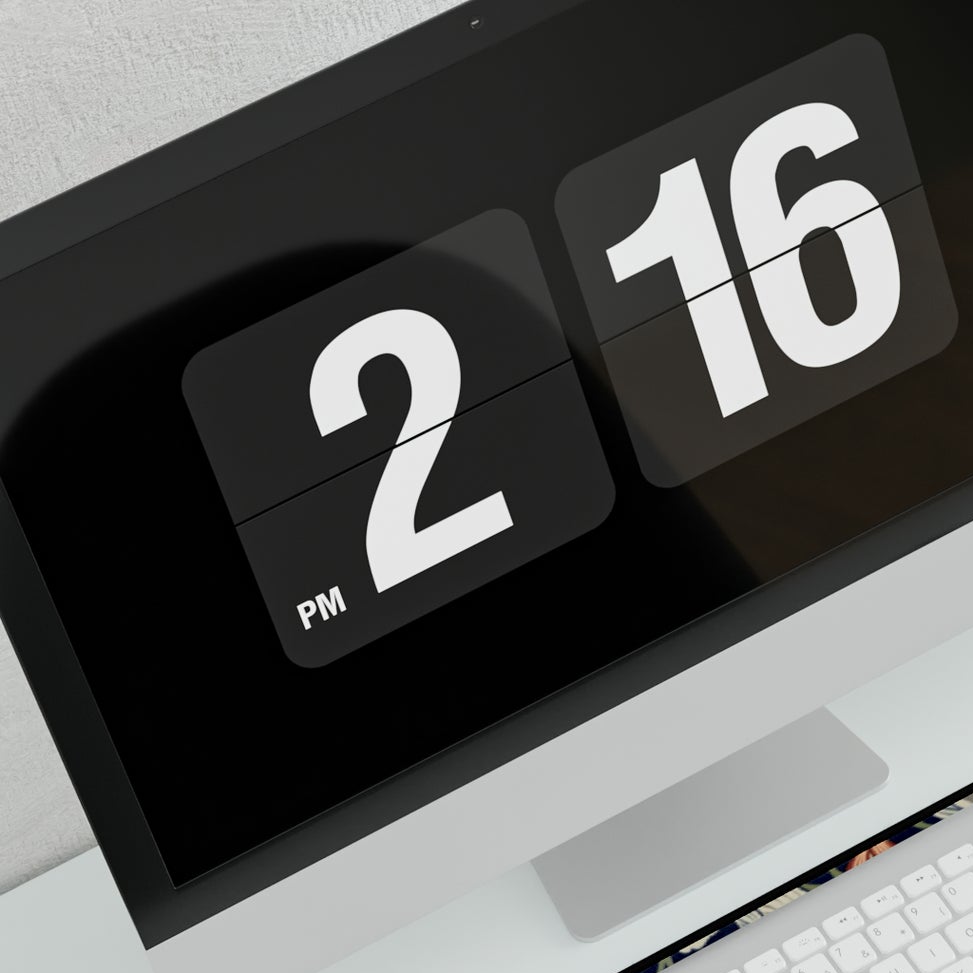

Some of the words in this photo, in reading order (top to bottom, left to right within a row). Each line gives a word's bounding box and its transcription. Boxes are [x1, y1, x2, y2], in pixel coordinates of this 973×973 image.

[309, 308, 514, 594] 2
[605, 102, 901, 419] 16
[296, 585, 347, 631] PM
[947, 886, 957, 896] 0
[910, 907, 918, 917] 9
[872, 927, 882, 937] 8
[834, 947, 842, 958] 7
